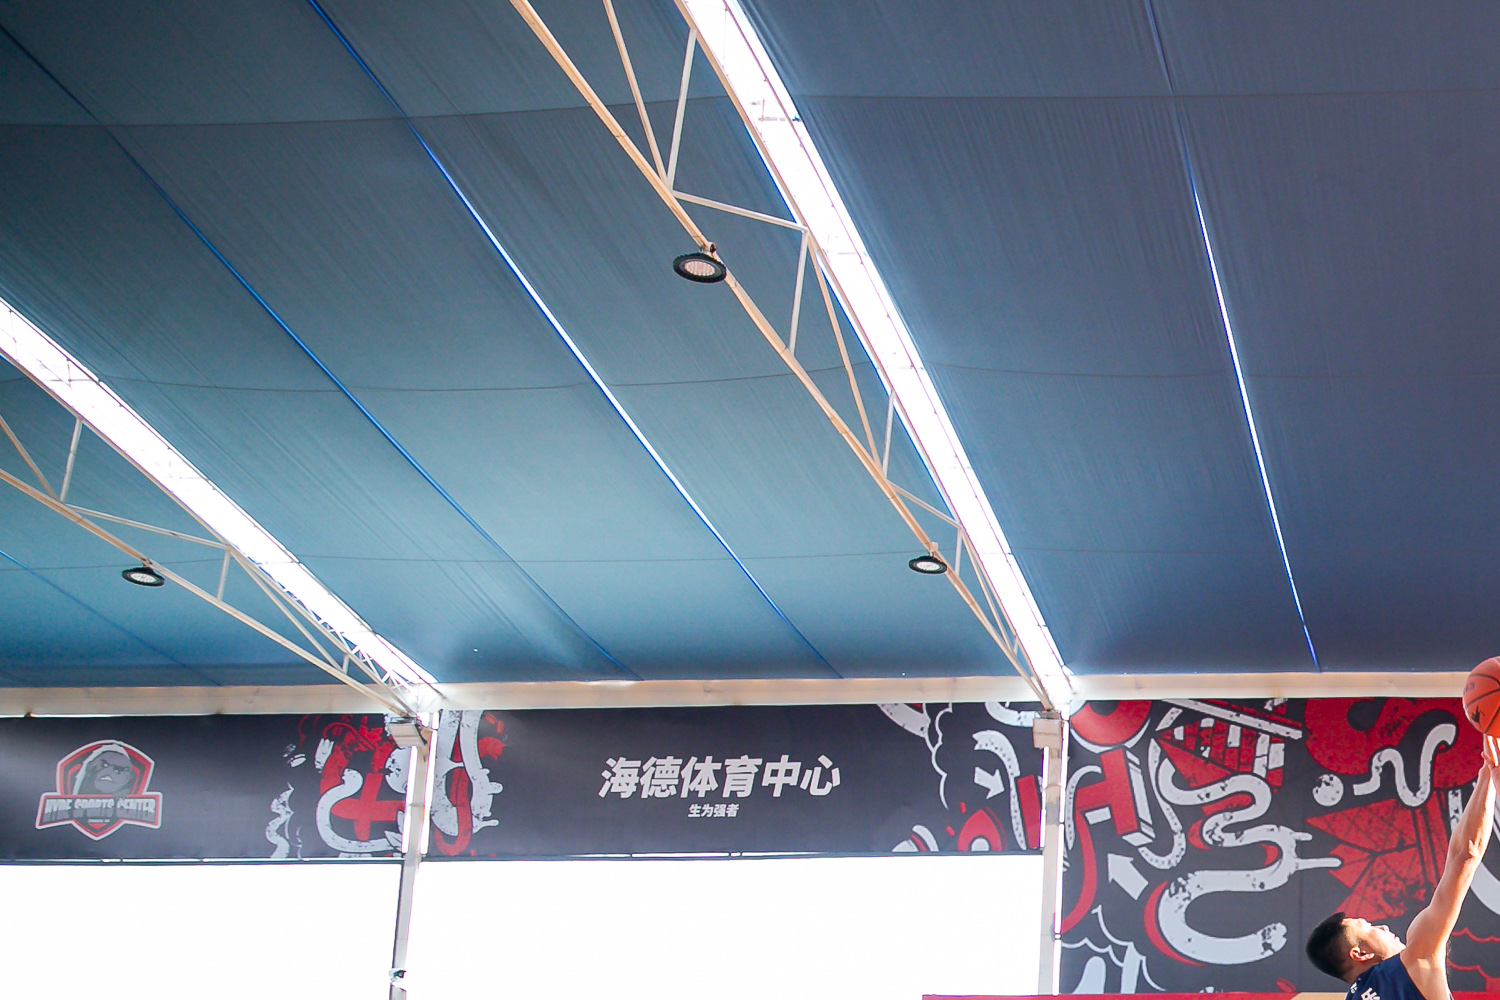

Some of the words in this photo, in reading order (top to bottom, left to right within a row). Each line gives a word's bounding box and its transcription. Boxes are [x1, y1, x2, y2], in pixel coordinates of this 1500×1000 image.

[598, 754, 841, 799] 海德体育中心
[687, 803, 740, 817] 生为强者
